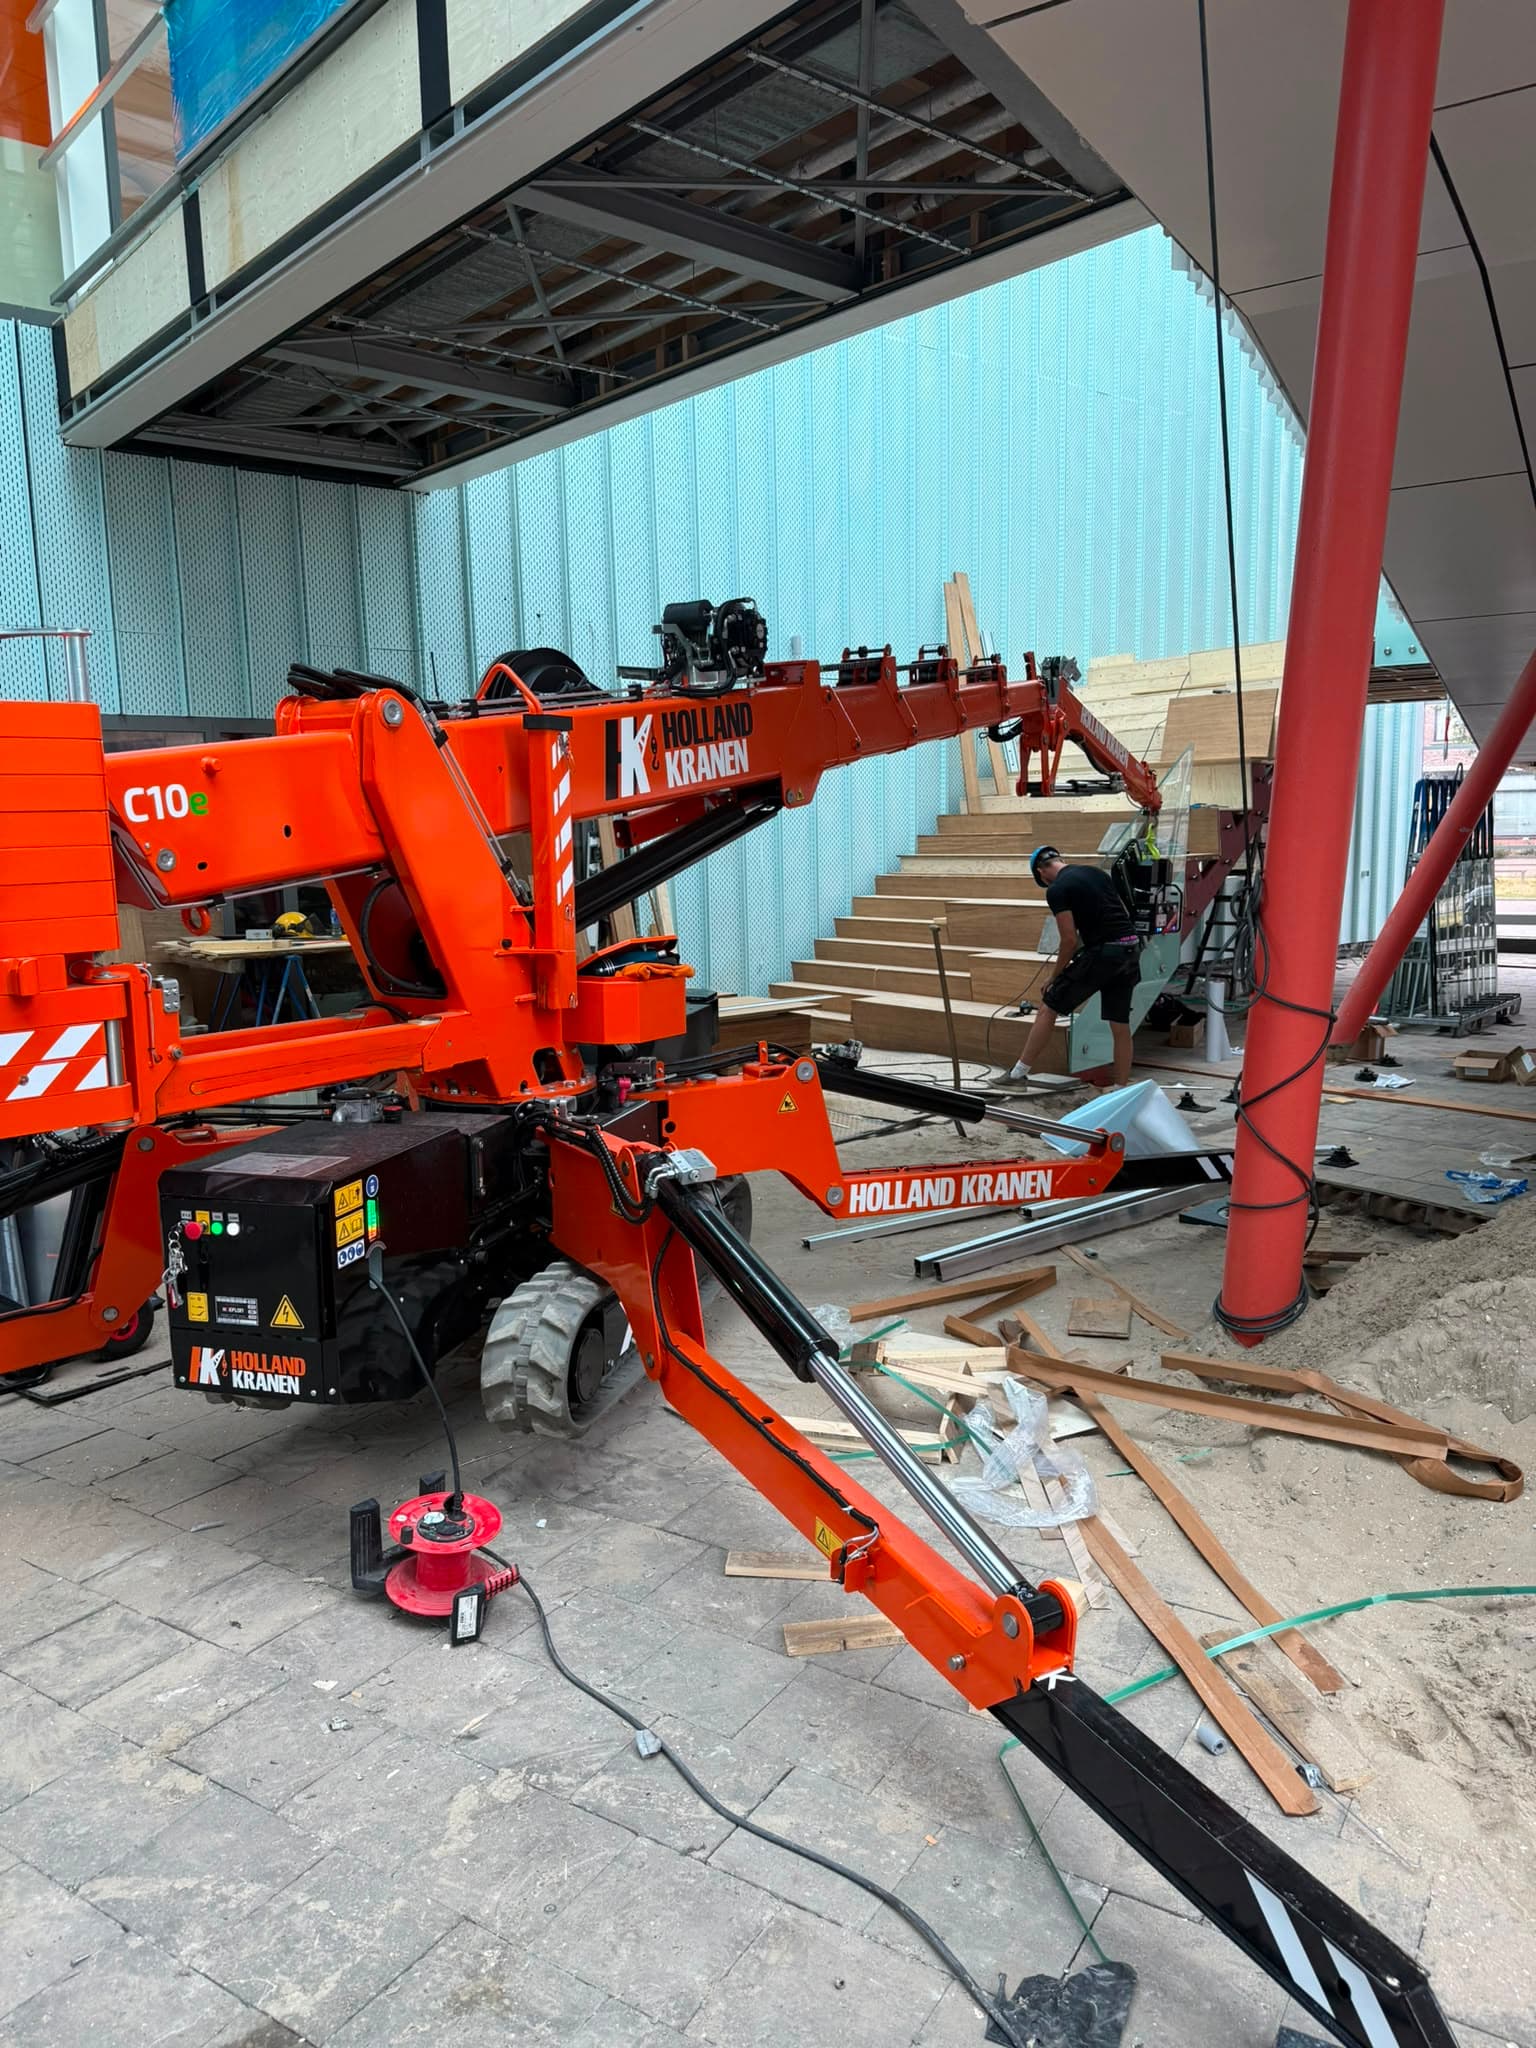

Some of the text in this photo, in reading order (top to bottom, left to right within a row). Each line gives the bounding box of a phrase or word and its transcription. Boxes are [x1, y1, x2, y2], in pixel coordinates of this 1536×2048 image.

[661, 702, 753, 749] HOLLAND
[664, 738, 750, 788] KRANEN
[123, 783, 209, 823] C10e
[849, 1169, 1053, 1214] HOLLAND KRANEN
[231, 1350, 307, 1377] HOLLAND
[231, 1369, 300, 1395] KRANEN
